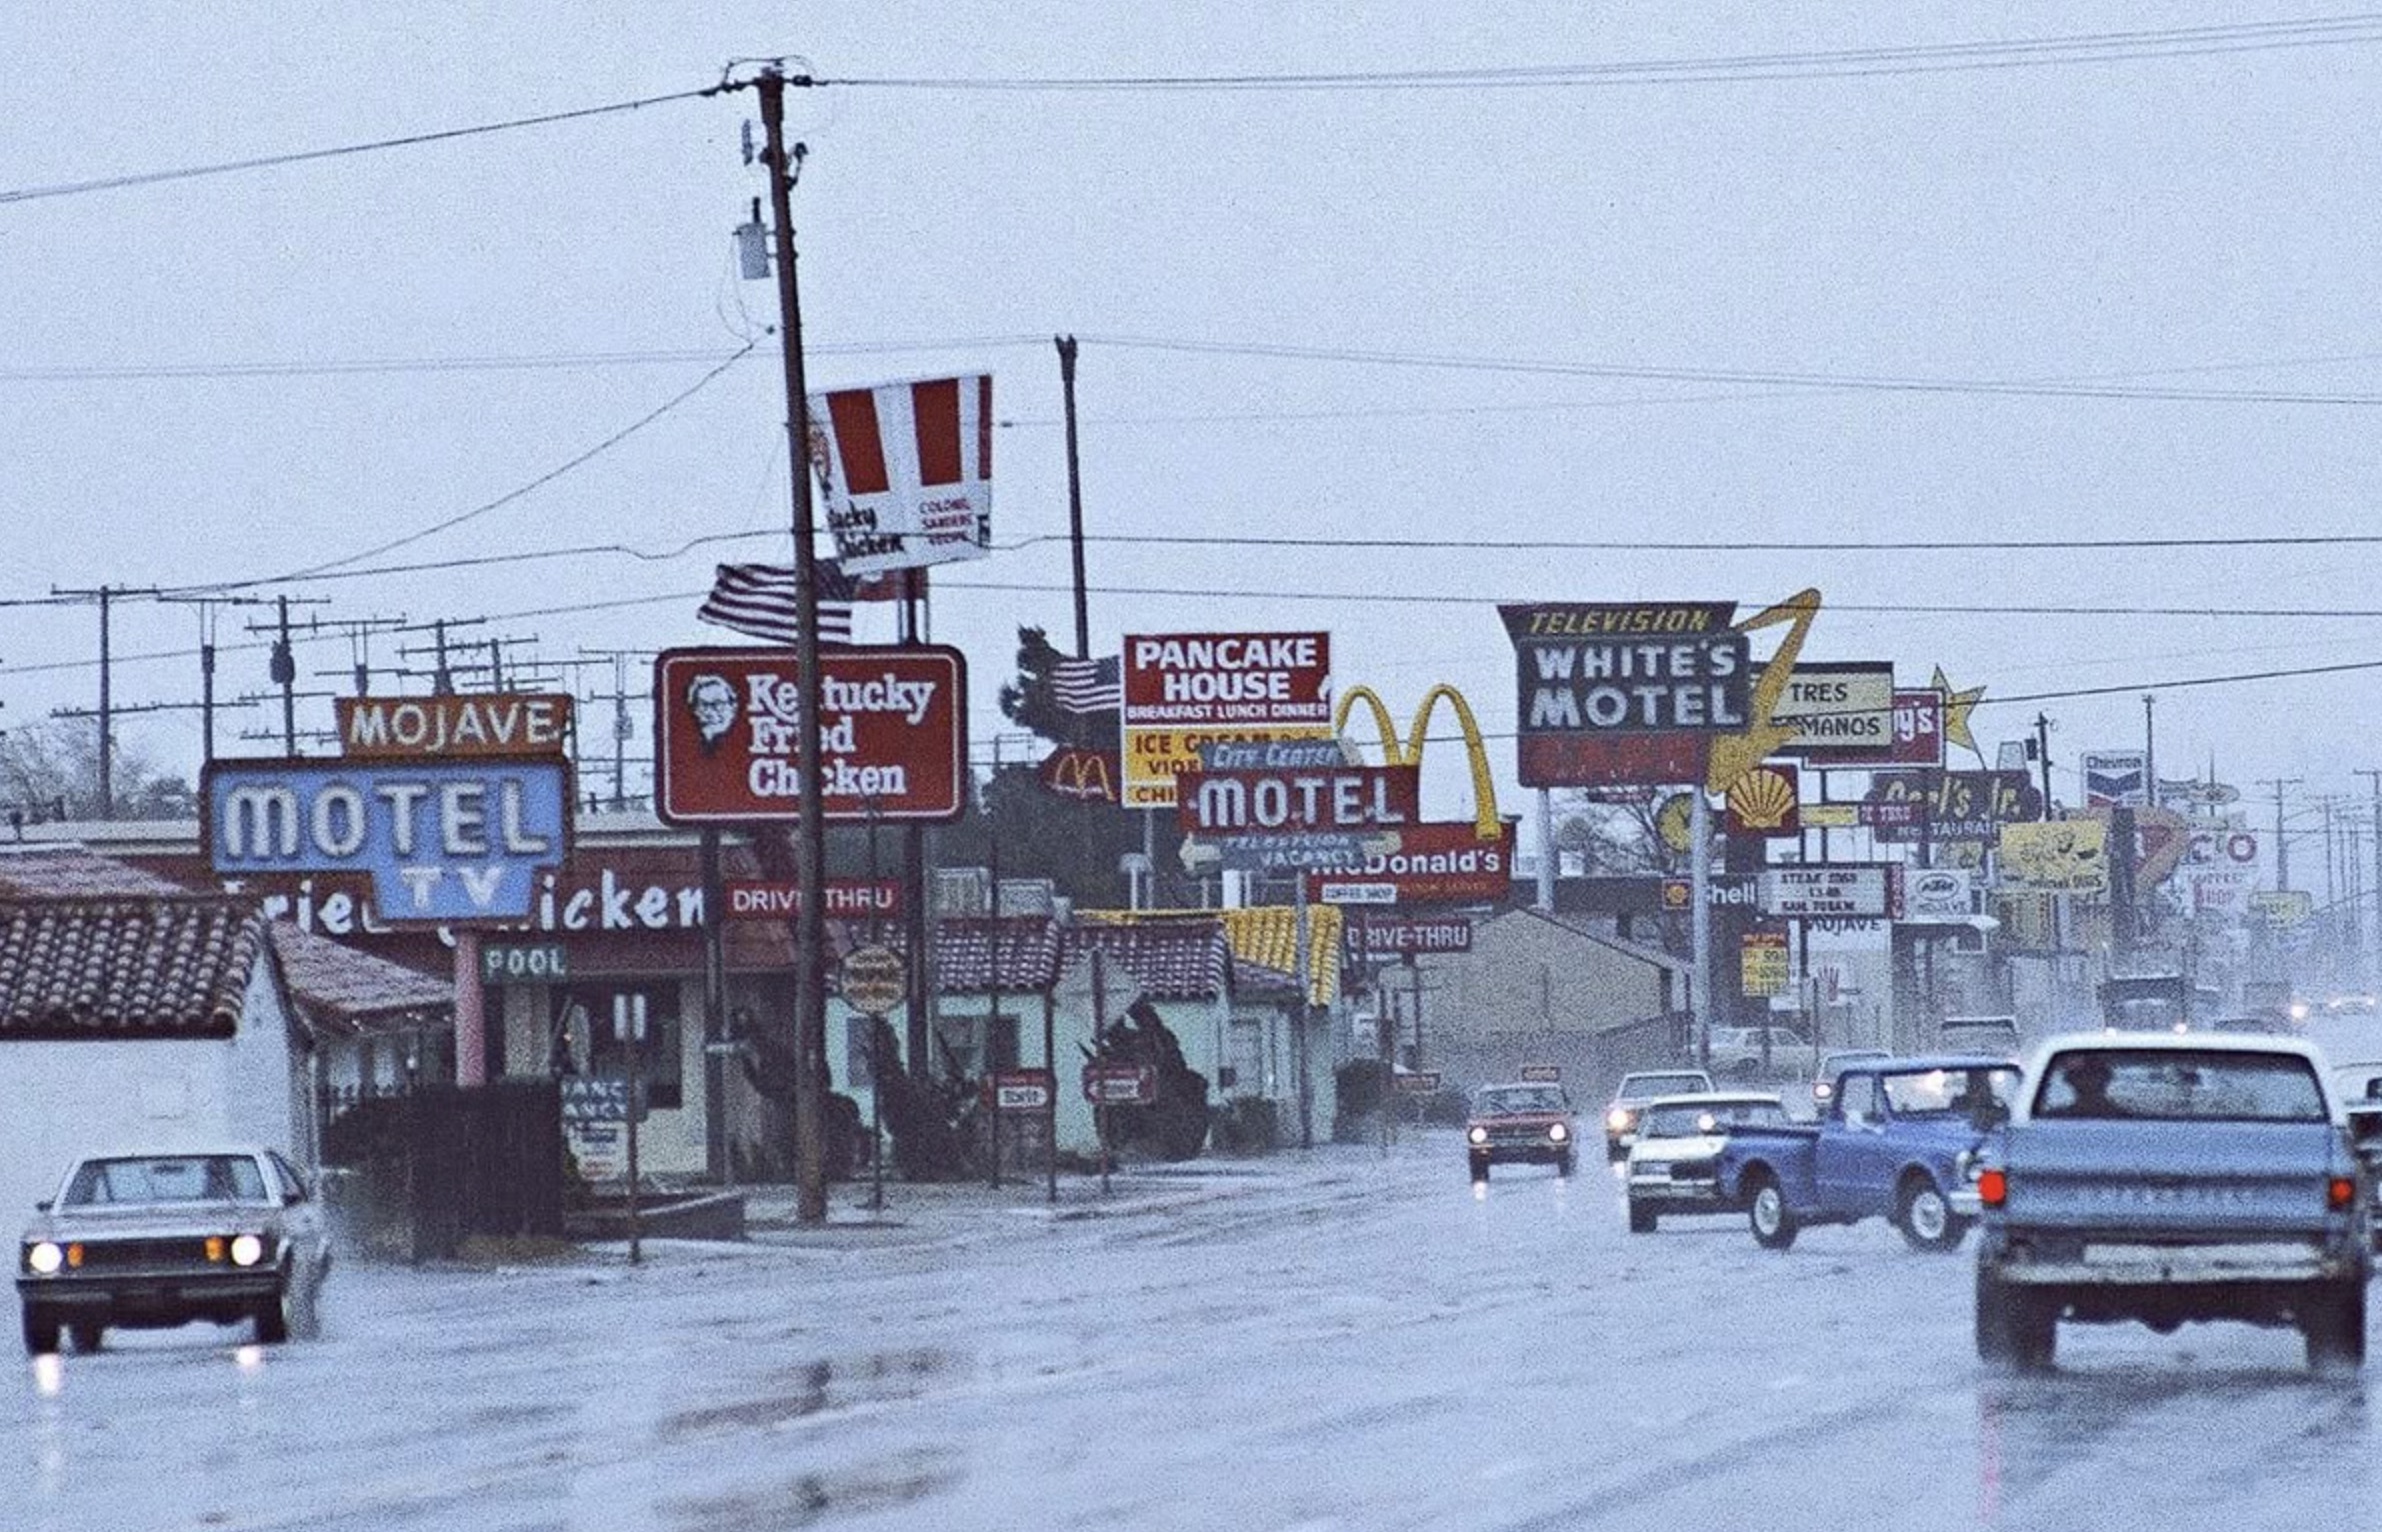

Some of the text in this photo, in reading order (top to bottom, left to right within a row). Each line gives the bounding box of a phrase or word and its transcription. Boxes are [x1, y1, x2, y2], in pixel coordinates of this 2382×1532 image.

[1530, 609, 1712, 633] TELEVISION
[1135, 637, 1317, 670] PANCAKE
[1535, 640, 1735, 679] WHITE'S
[747, 673, 935, 724] Ketucky
[1165, 672, 1290, 701] HOUSE
[1791, 682, 1848, 702] TRES
[1127, 703, 1328, 719] BREAKFAST LUNCH DINNER
[1530, 684, 1742, 727] MOTEL
[350, 701, 558, 750] MOJAVE
[749, 716, 856, 752] Frd
[1136, 734, 1172, 754] ICE
[749, 758, 906, 797] Chcken
[223, 780, 547, 858] MOTEL
[1200, 777, 1404, 828] MOTEL
[1311, 851, 1499, 875] Donald's
[401, 867, 505, 907] TV
[825, 887, 892, 909] THRU
[1707, 883, 1755, 905] hell
[487, 949, 565, 978] POOL
